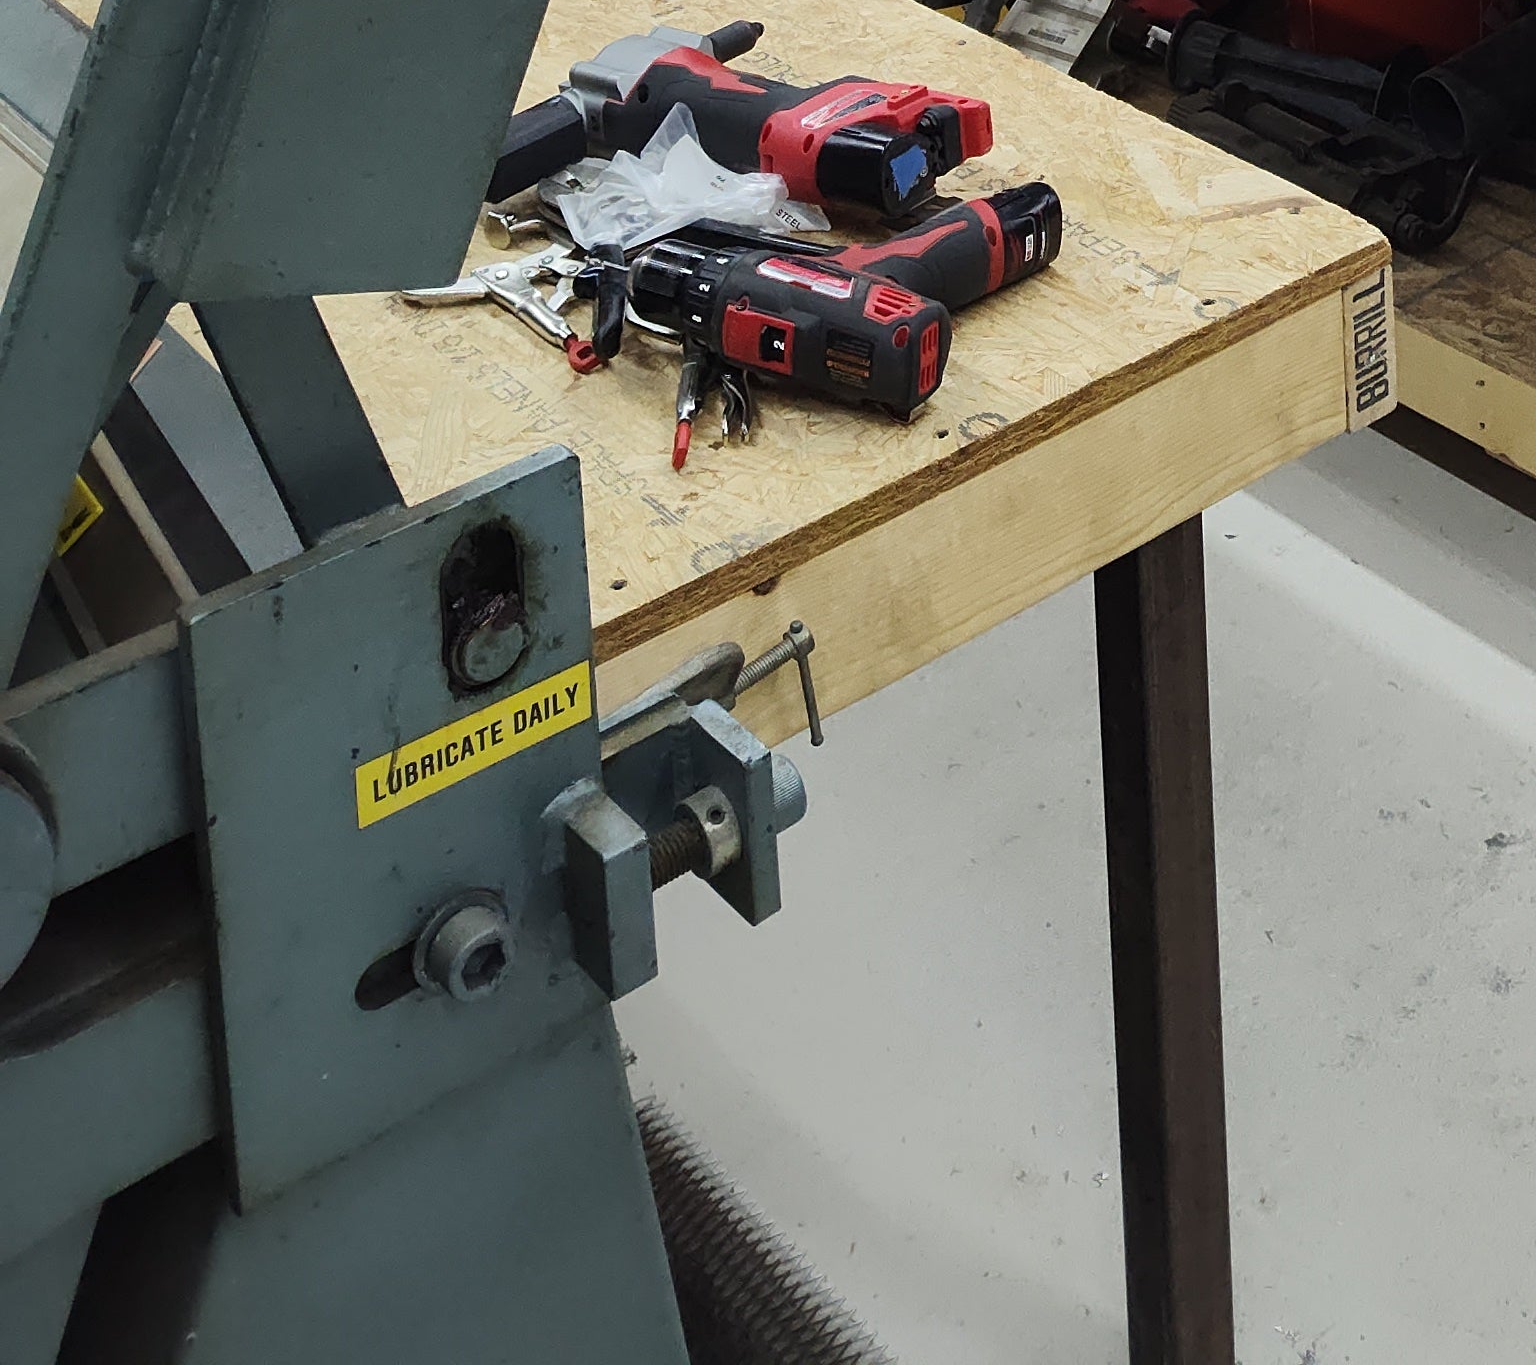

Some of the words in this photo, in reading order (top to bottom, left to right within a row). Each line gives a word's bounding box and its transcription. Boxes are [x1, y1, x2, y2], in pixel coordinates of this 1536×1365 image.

[775, 208, 801, 230] STEEL
[699, 283, 711, 292] 2
[774, 339, 785, 350] 2
[1352, 267, 1389, 413] BURRILL
[372, 719, 504, 803] LUBRICATE
[513, 682, 579, 735] DAILY
